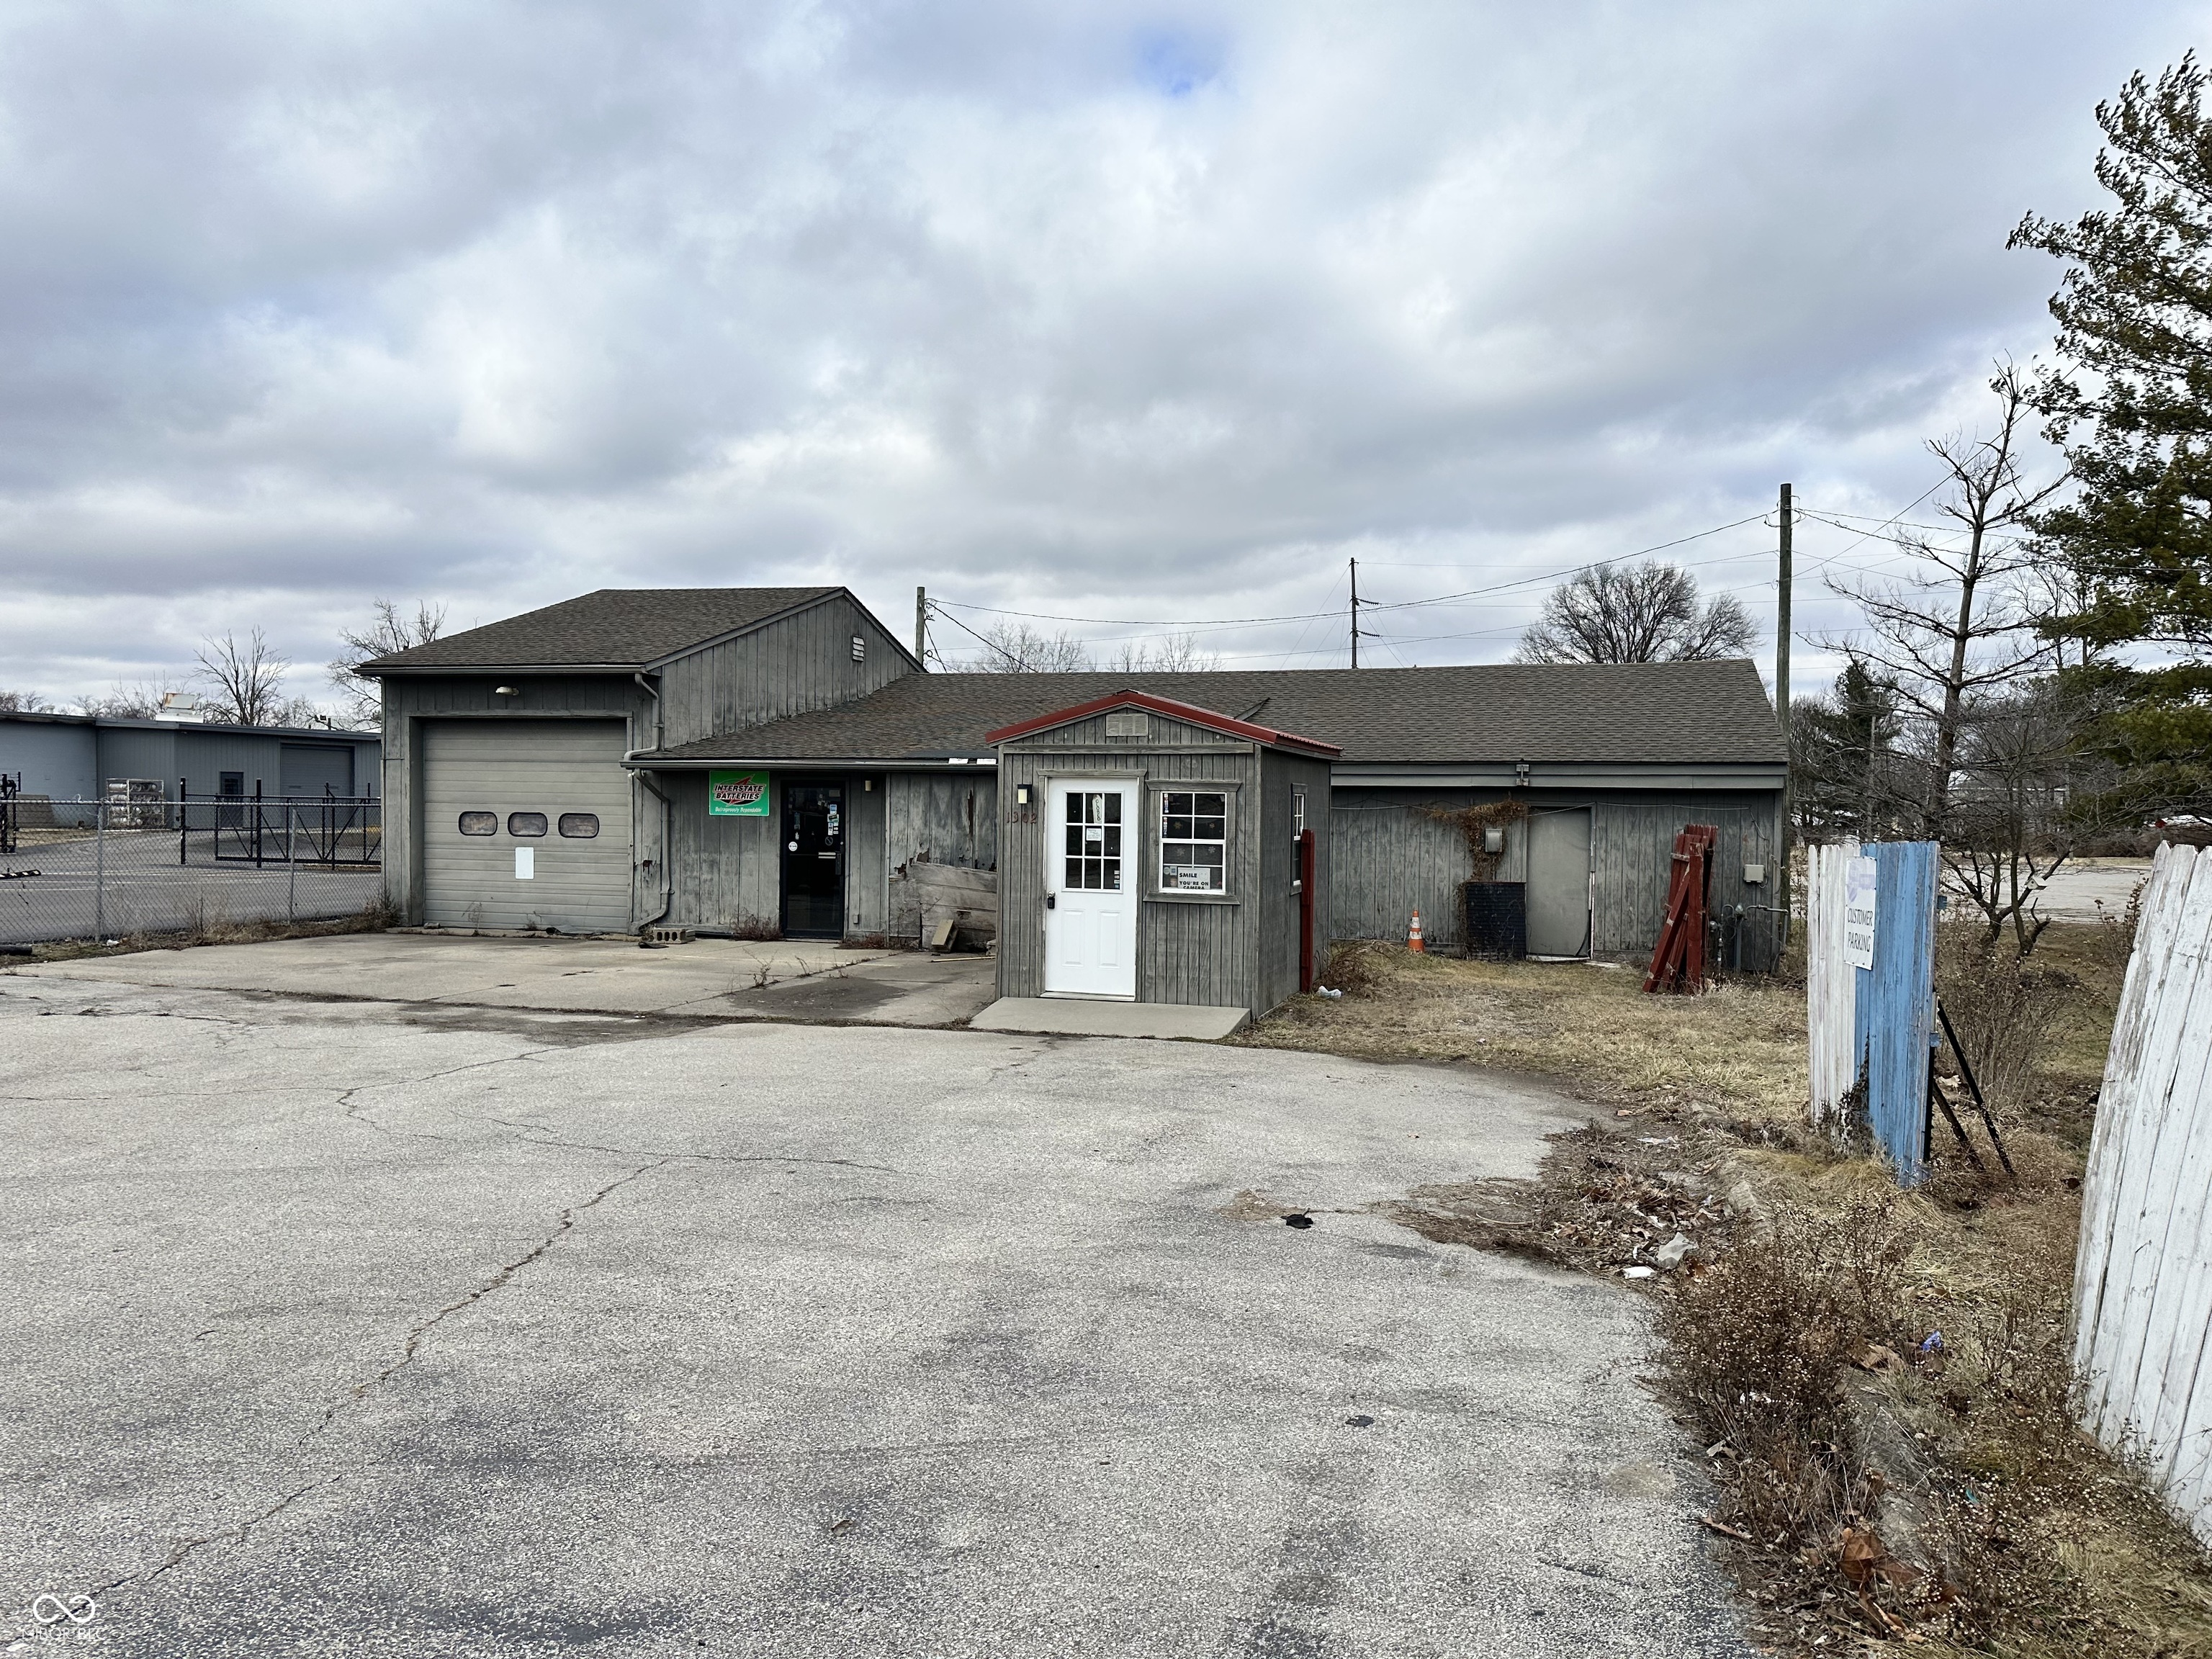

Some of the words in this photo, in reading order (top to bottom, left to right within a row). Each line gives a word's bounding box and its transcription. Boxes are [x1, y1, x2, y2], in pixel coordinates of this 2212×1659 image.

[1007, 811, 1037, 824] 1302
[1847, 907, 1874, 927] CUSTOMER
[1847, 931, 1871, 953] PARKING
